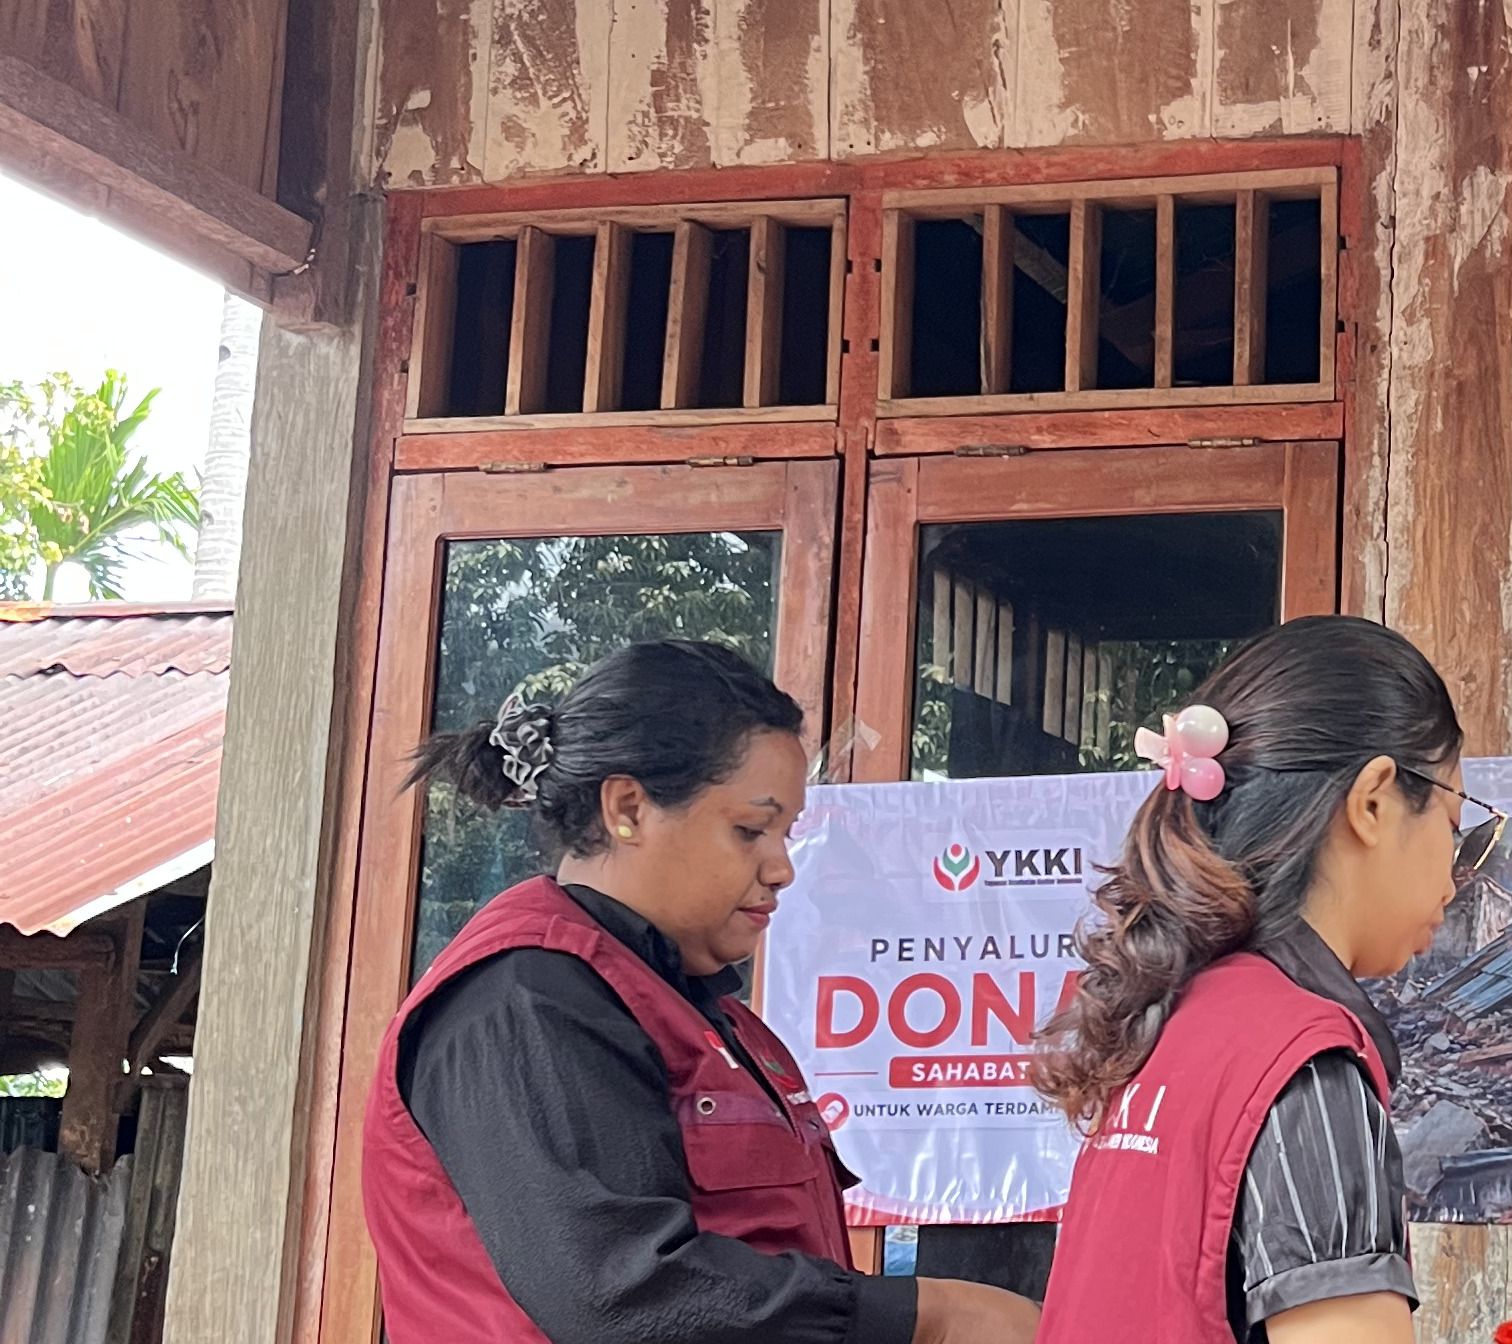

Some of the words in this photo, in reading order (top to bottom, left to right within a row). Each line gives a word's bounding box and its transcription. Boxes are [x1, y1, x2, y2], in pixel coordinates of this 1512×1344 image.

[985, 848, 1082, 877] YKKI
[870, 934, 1076, 962] PENYALUR
[912, 1061, 1031, 1082] SAHABAT
[854, 1104, 910, 1117] UNTUK
[917, 1102, 978, 1116] WARGA
[985, 1102, 1058, 1115] TERDAM
